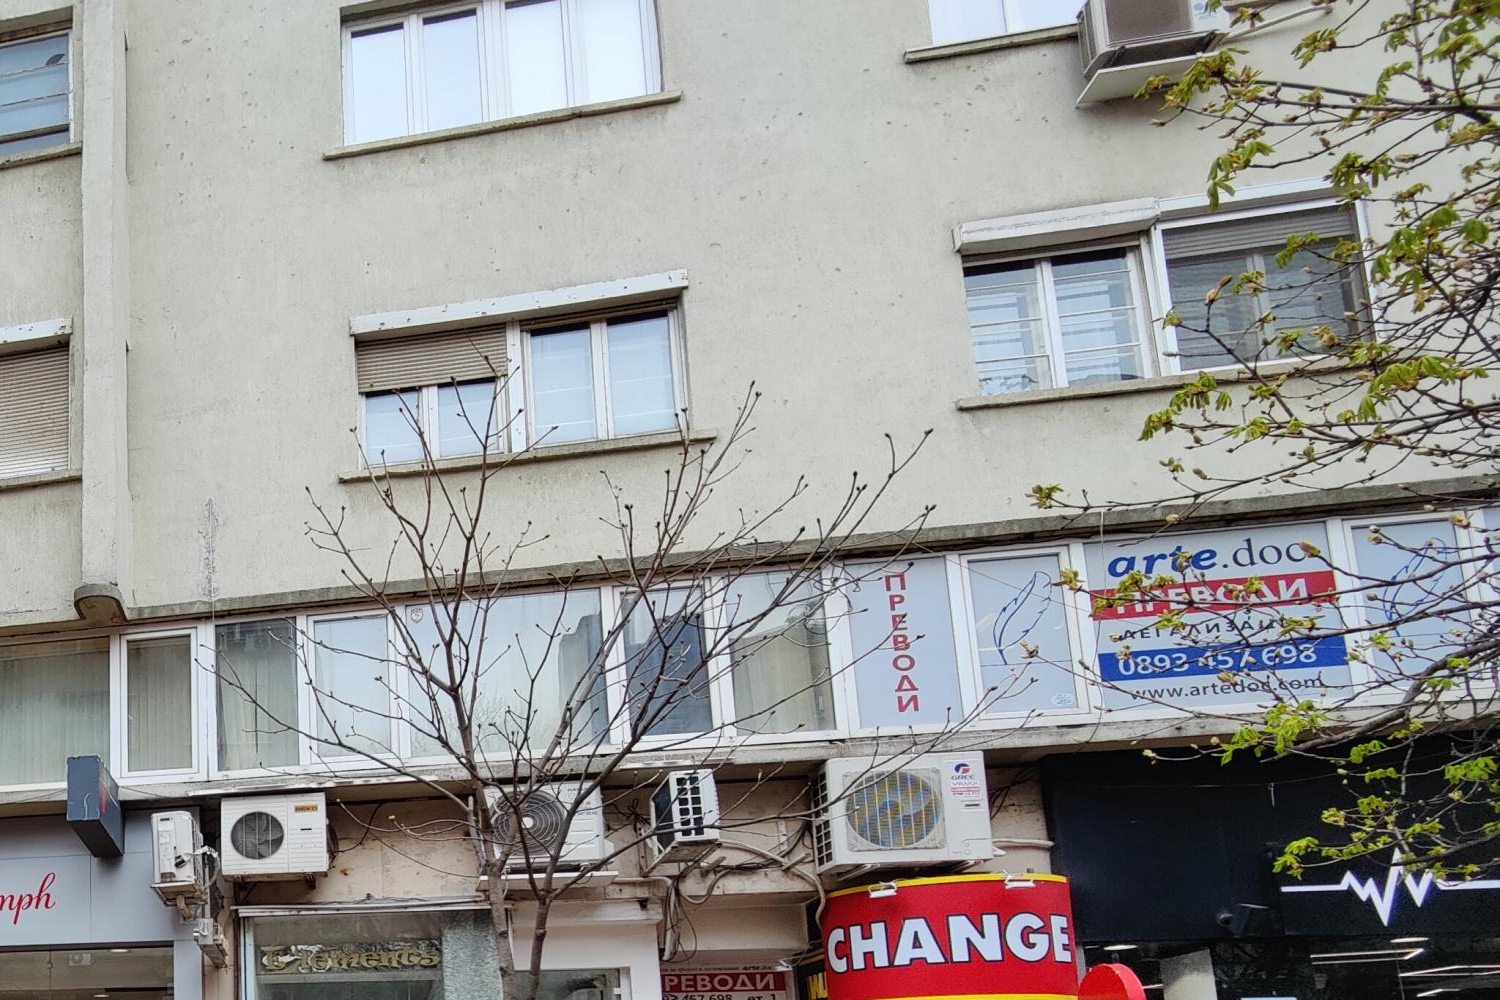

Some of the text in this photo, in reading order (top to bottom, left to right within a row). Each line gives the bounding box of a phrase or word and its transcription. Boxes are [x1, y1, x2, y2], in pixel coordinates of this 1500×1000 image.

[1108, 538, 1308, 578] arte.doc
[885, 573, 920, 712] ПРЕВОДИ
[1118, 652, 1188, 676] 0893
[1262, 644, 1317, 665] 698
[1130, 676, 1324, 701] www.artedoc.com
[827, 912, 1073, 973] CHANGE
[664, 973, 775, 992] РЕВОДИ
